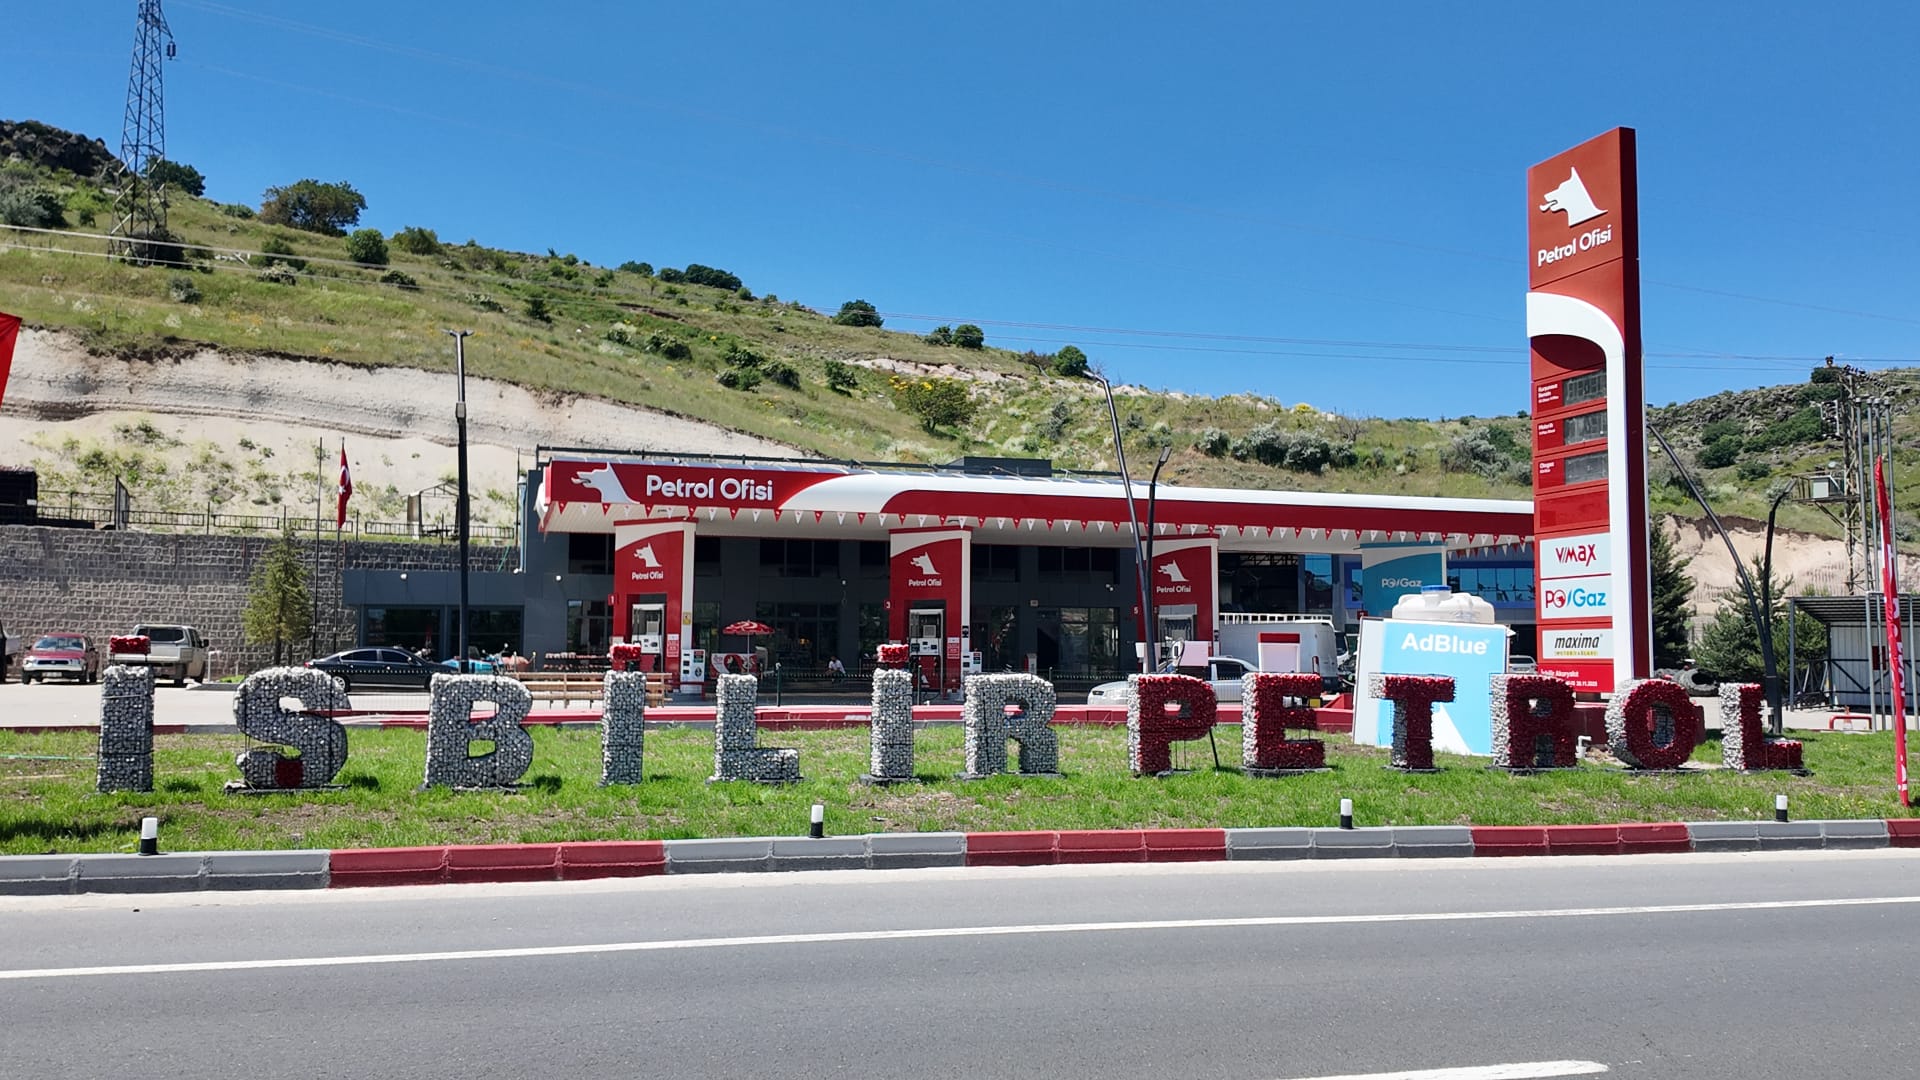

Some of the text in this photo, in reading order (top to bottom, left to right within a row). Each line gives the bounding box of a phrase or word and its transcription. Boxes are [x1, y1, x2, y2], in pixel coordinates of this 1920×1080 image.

[1537, 224, 1612, 267] Petrol Ofisi
[646, 474, 773, 501] Petrol Ofisi
[631, 571, 664, 580] Petrol Ofisi
[908, 578, 942, 587] Petrol Ofisi
[1176, 585, 1192, 593] Ofisi
[1554, 633, 1600, 649] maxima
[1126, 671, 1803, 776] PETROL
